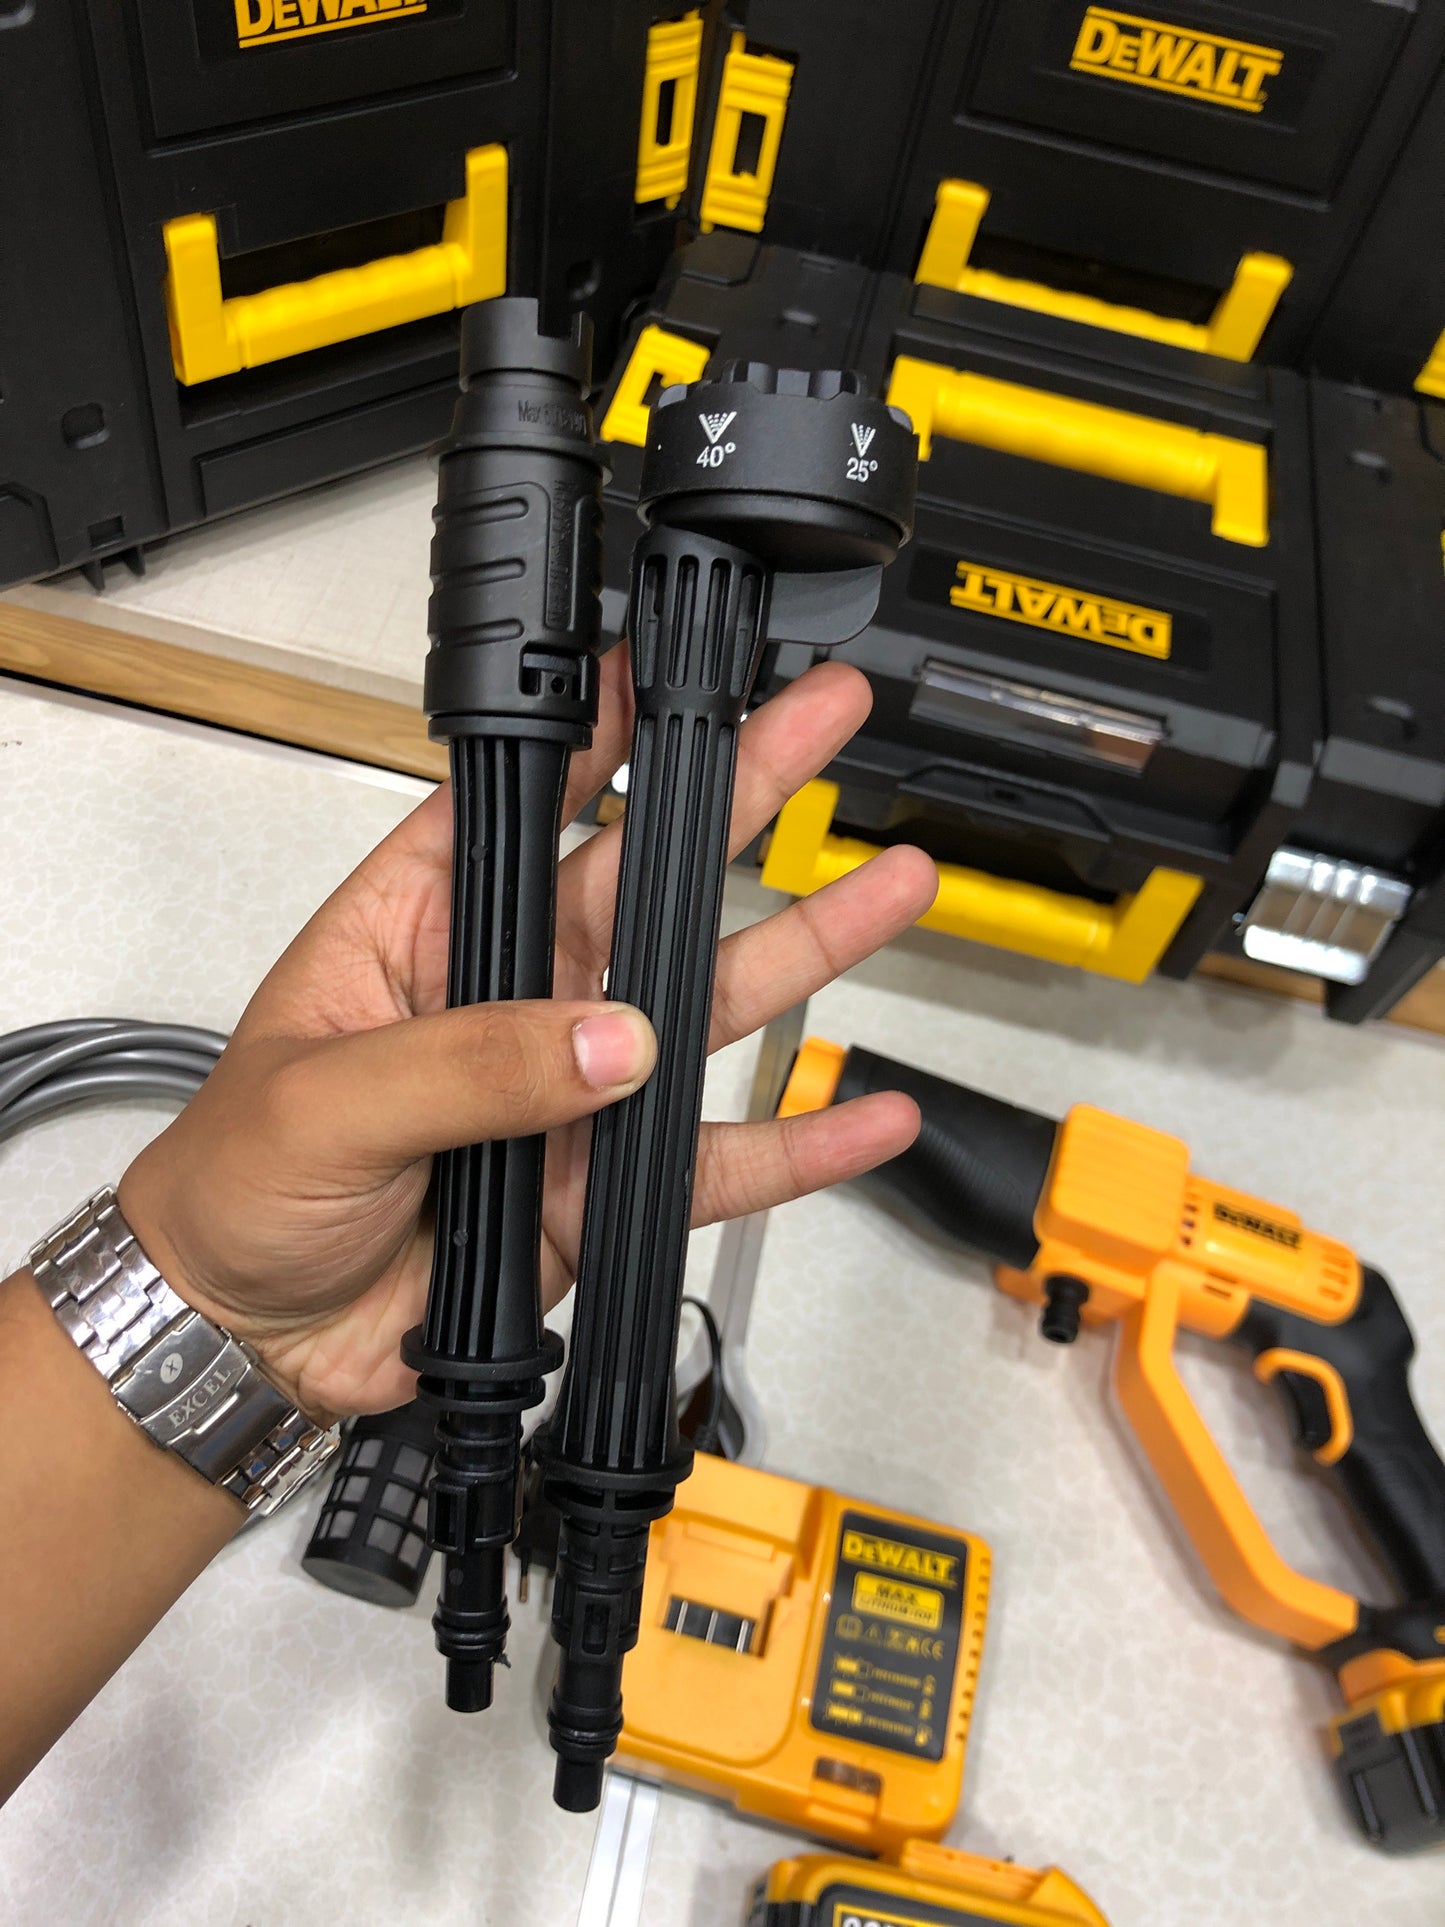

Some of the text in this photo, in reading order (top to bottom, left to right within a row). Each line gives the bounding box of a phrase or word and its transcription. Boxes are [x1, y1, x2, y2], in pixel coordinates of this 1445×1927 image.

[234, 0, 427, 38] DEW
[1072, 15, 1283, 100] DEWALT
[951, 573, 1172, 654] DEWALT
[168, 1369, 232, 1428] EXCEL
[842, 1531, 957, 1582] DEWALT
